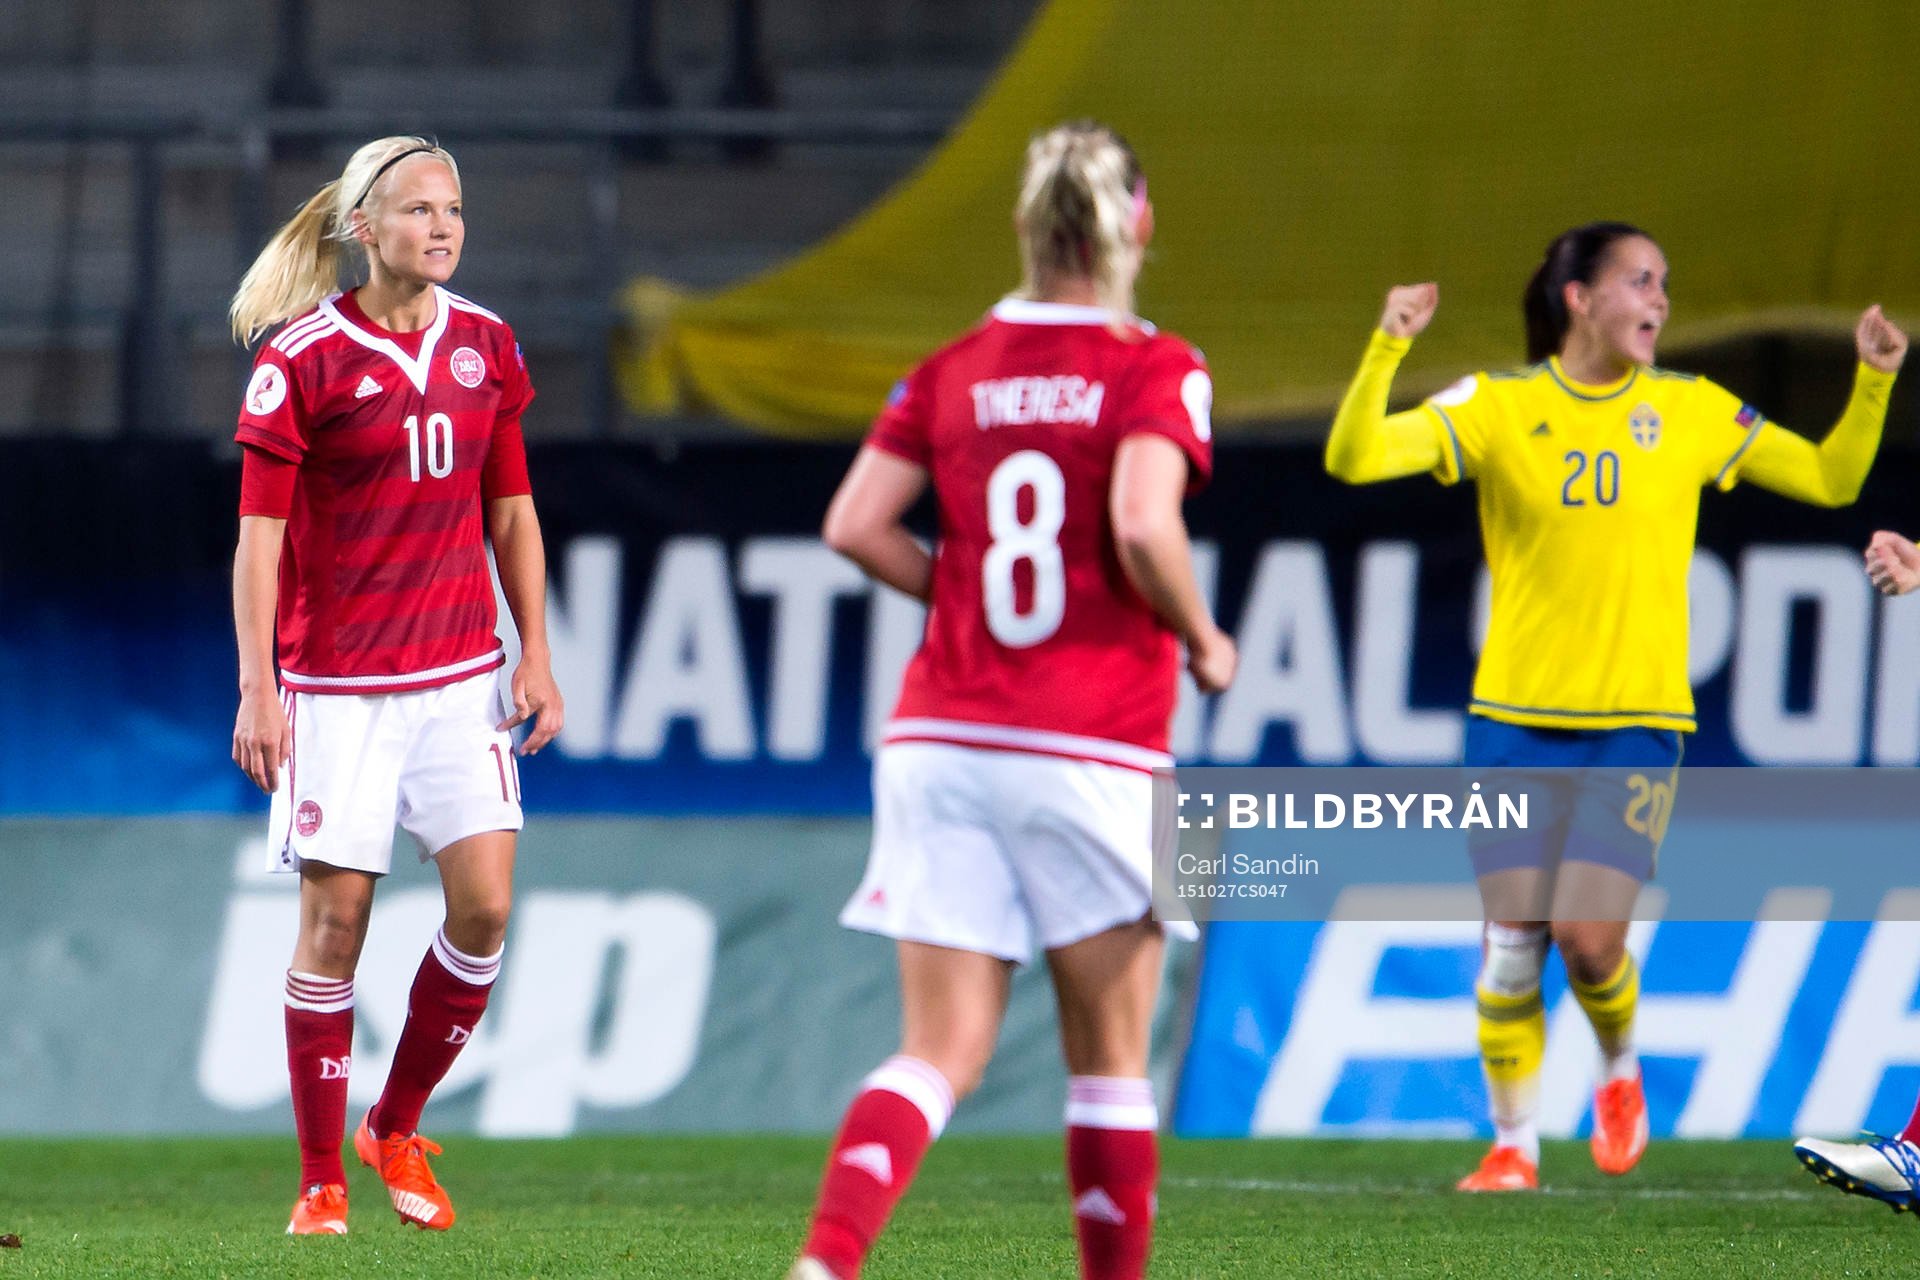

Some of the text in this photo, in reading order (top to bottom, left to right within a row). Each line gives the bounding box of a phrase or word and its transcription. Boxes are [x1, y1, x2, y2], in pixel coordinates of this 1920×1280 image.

[970, 375, 1104, 430] THERESA
[403, 412, 454, 483] 10
[1561, 450, 1620, 507] 20
[983, 449, 1067, 649] 8
[488, 536, 1465, 765] NATIAL
[1624, 773, 1674, 843] 20
